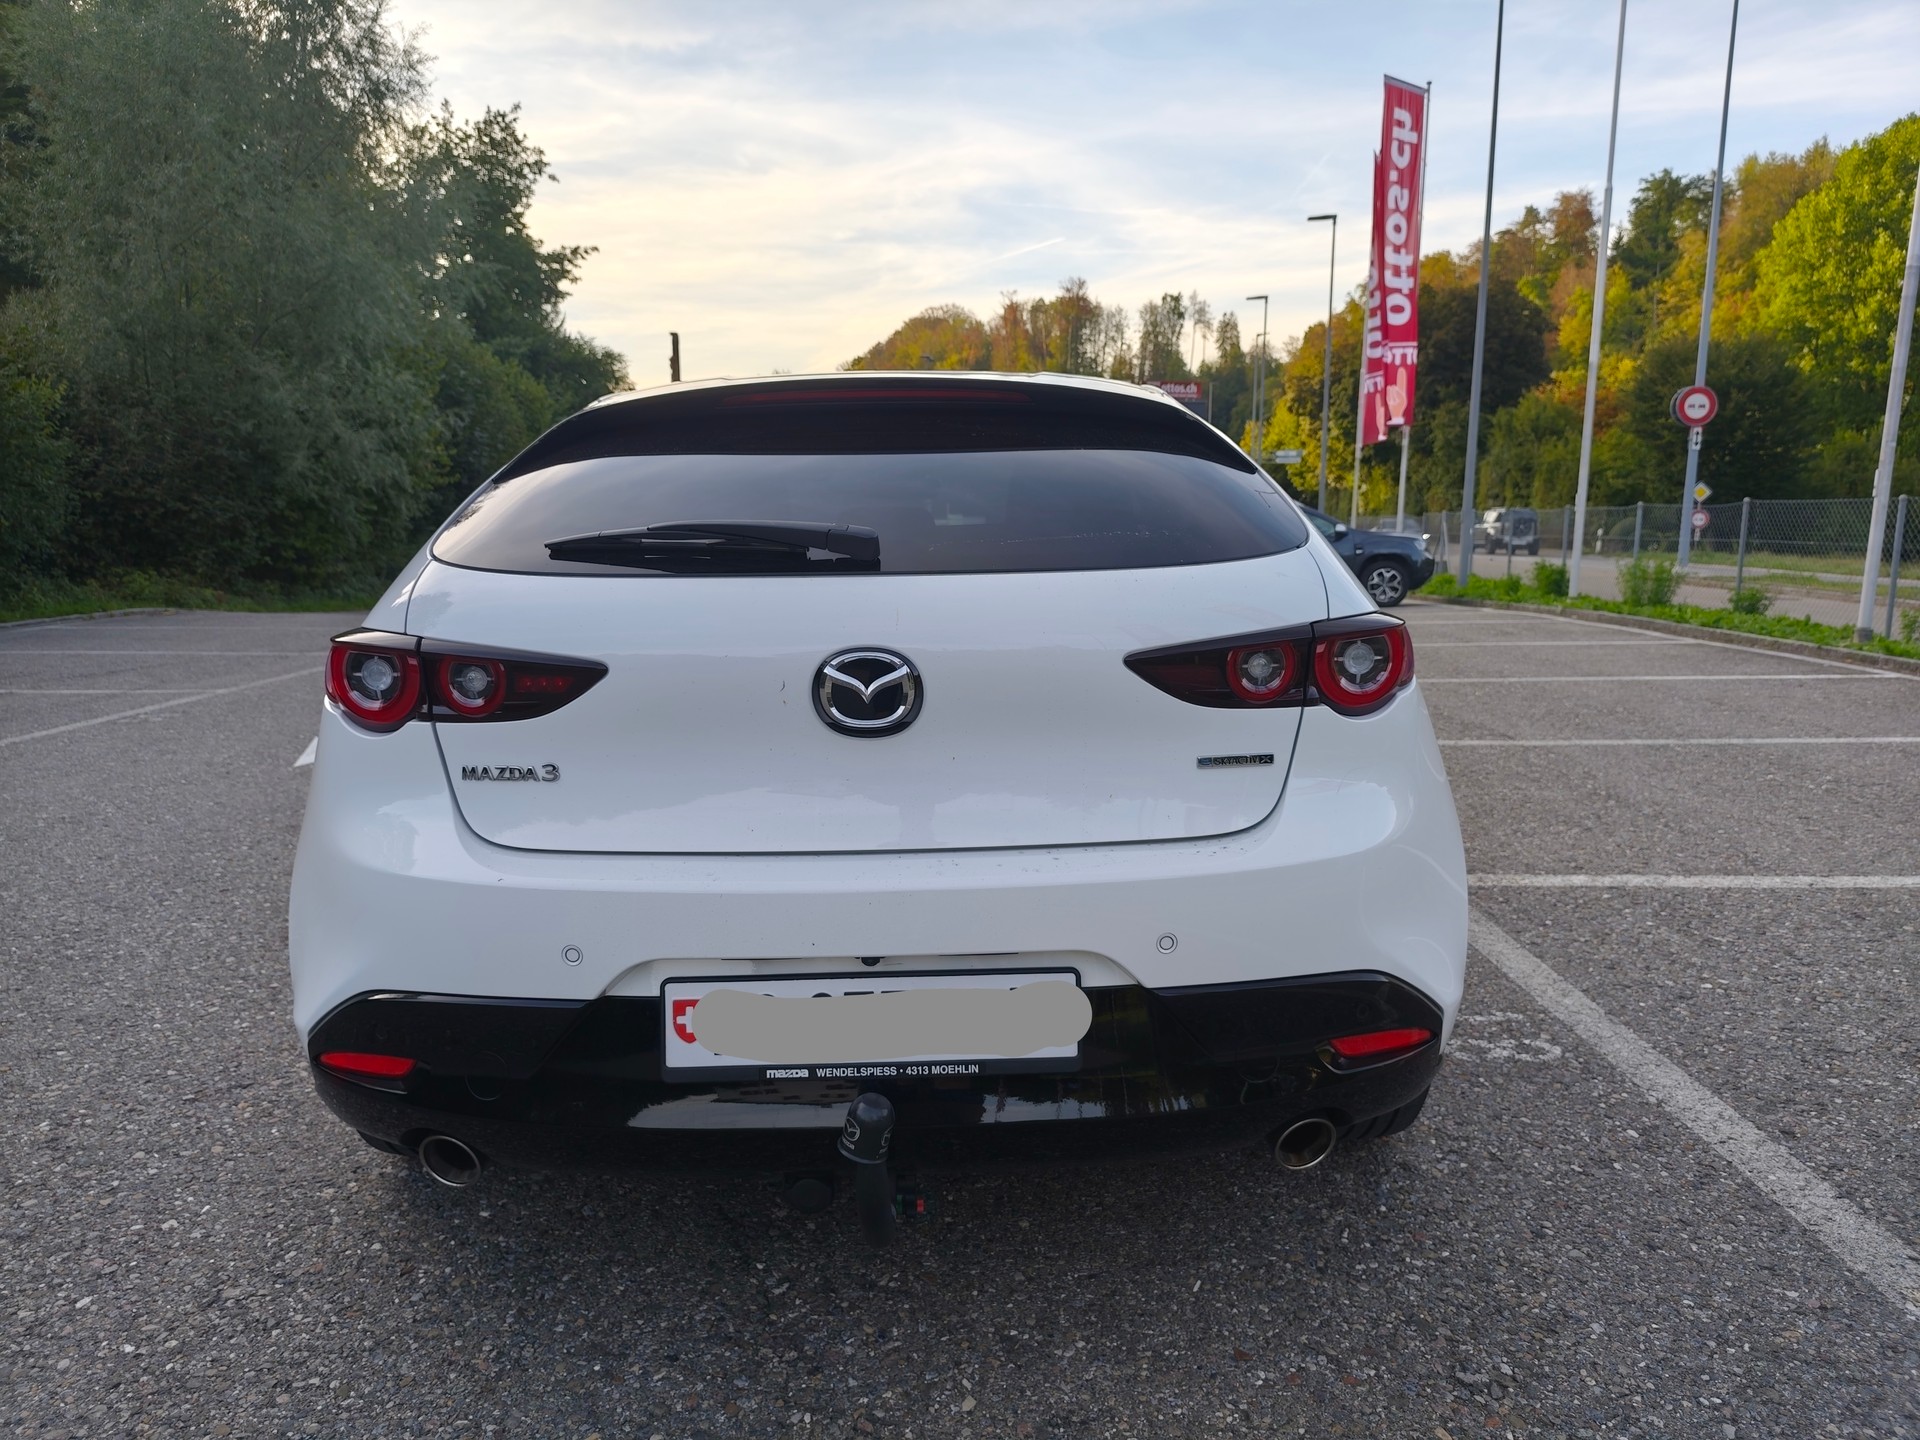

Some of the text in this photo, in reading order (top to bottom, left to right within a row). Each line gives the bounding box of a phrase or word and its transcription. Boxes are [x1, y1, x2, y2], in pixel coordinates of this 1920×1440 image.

[766, 1063, 979, 1079] mazda WENDELSPIESS 4313 MOEHLIN
